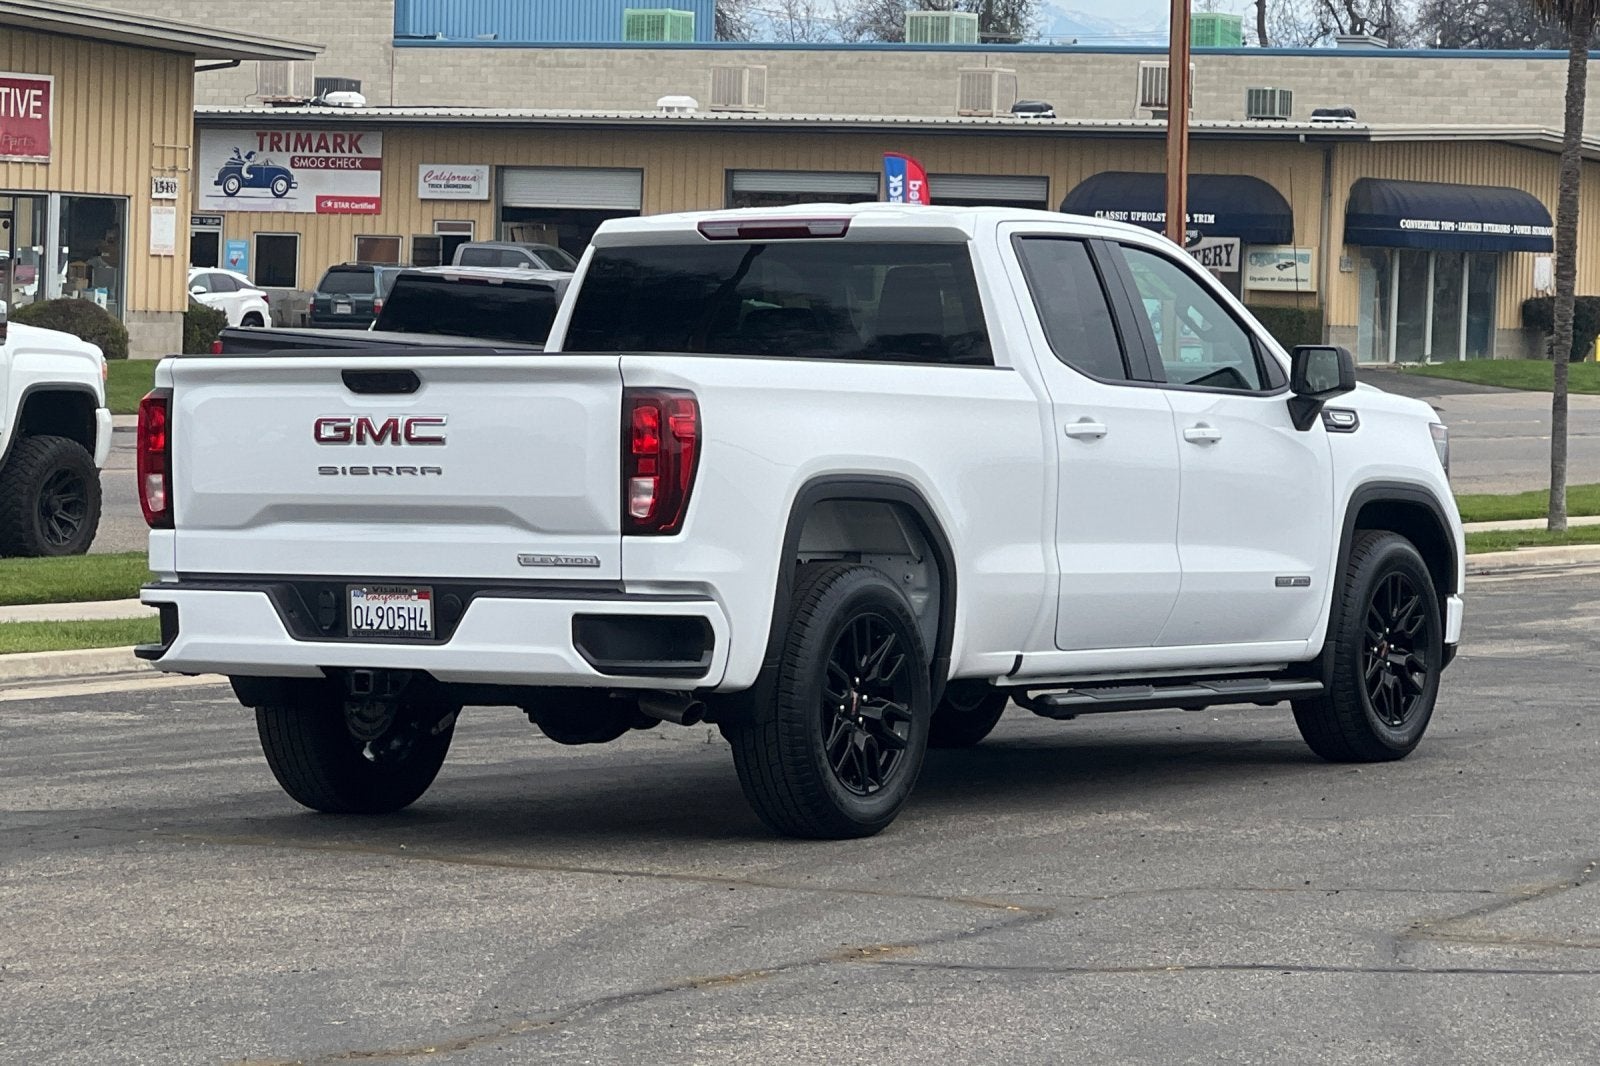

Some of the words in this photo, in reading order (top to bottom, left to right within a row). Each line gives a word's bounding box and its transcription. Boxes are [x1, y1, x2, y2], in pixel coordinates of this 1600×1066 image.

[256, 131, 364, 154] TRIMARK
[294, 157, 326, 168] SMOG
[328, 158, 362, 169] CHECK
[423, 170, 479, 183] California
[333, 201, 350, 209] STAR
[1094, 210, 1129, 221] CLASSIC
[1130, 211, 1167, 222] UPHOLST
[1193, 213, 1215, 224] TRIM
[1400, 218, 1440, 231] CONVERTIBLE
[1441, 221, 1455, 232] TOPS
[1458, 221, 1482, 232] LEATHER
[1482, 222, 1511, 234] INTERIORS
[1513, 224, 1532, 235] POWER
[313, 414, 448, 446] GMC
[317, 465, 443, 477] SIERRA
[523, 556, 595, 565] ELEVATION
[354, 604, 428, 631] 04905H4
